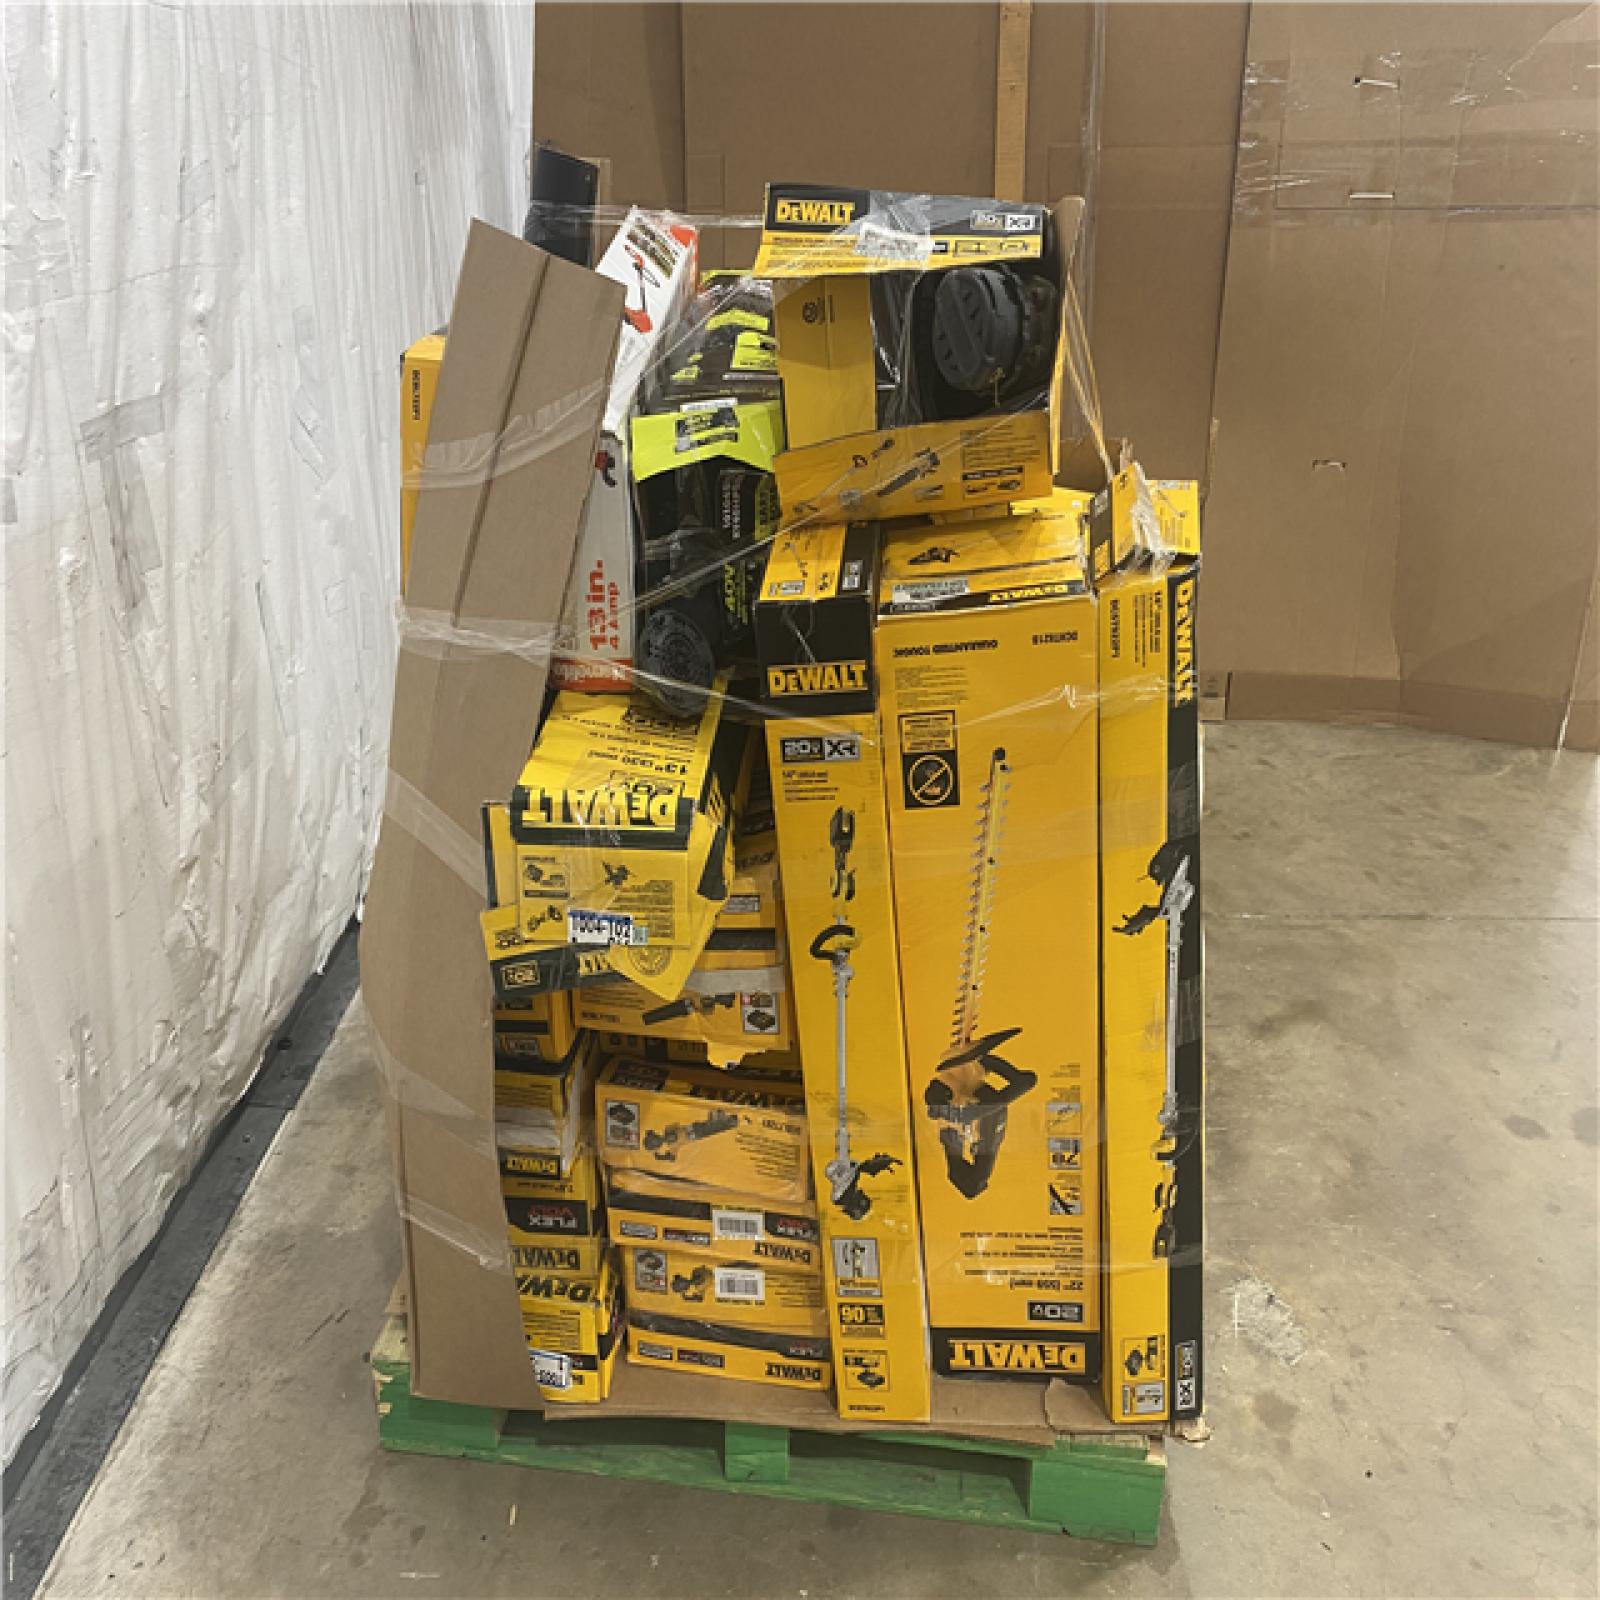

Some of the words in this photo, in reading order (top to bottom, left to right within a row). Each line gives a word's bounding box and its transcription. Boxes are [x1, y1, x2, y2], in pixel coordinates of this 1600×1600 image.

[776, 199, 856, 225] DEWALT
[585, 559, 607, 603] in.
[588, 607, 607, 651] 13
[1175, 579, 1194, 708] DEWALT
[932, 639, 999, 655] GUARANTEED
[767, 663, 868, 695] DEWALT
[520, 787, 679, 828] DEWALT
[753, 1242, 812, 1264] DEWALT
[949, 1340, 1086, 1371] DEWALT
[764, 1362, 823, 1382] DEWALT
